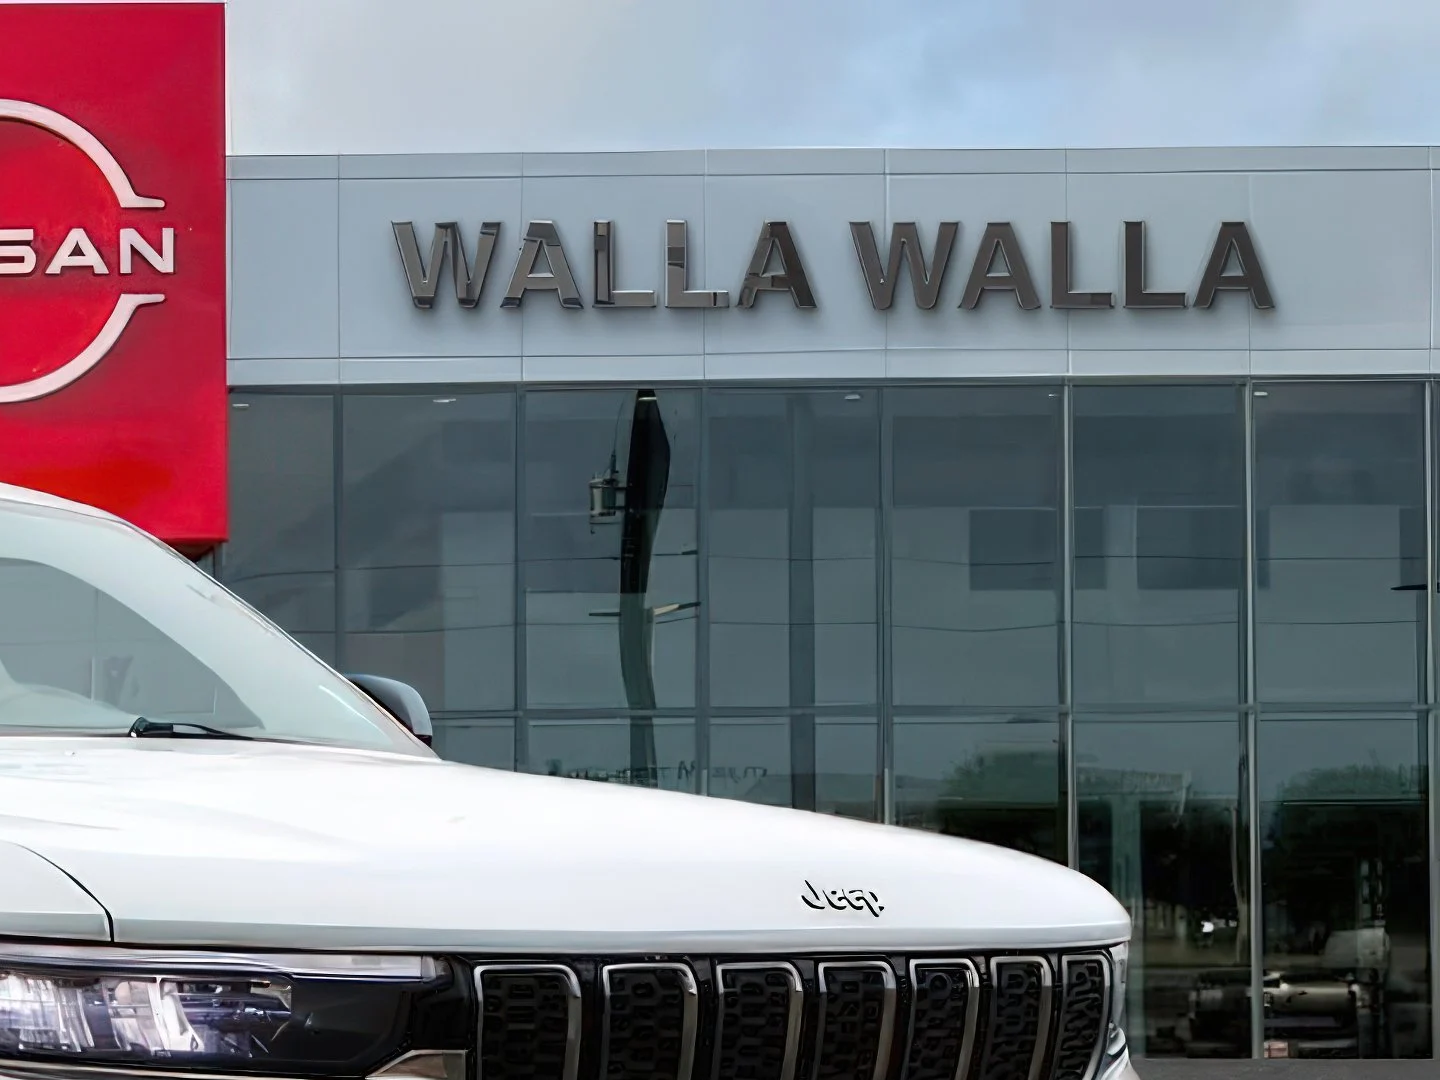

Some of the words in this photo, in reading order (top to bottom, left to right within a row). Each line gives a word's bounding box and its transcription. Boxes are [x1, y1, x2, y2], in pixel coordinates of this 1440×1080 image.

[391, 219, 818, 311] WALLA
[848, 219, 1276, 311] WALLA
[800, 878, 884, 918] Jeep
